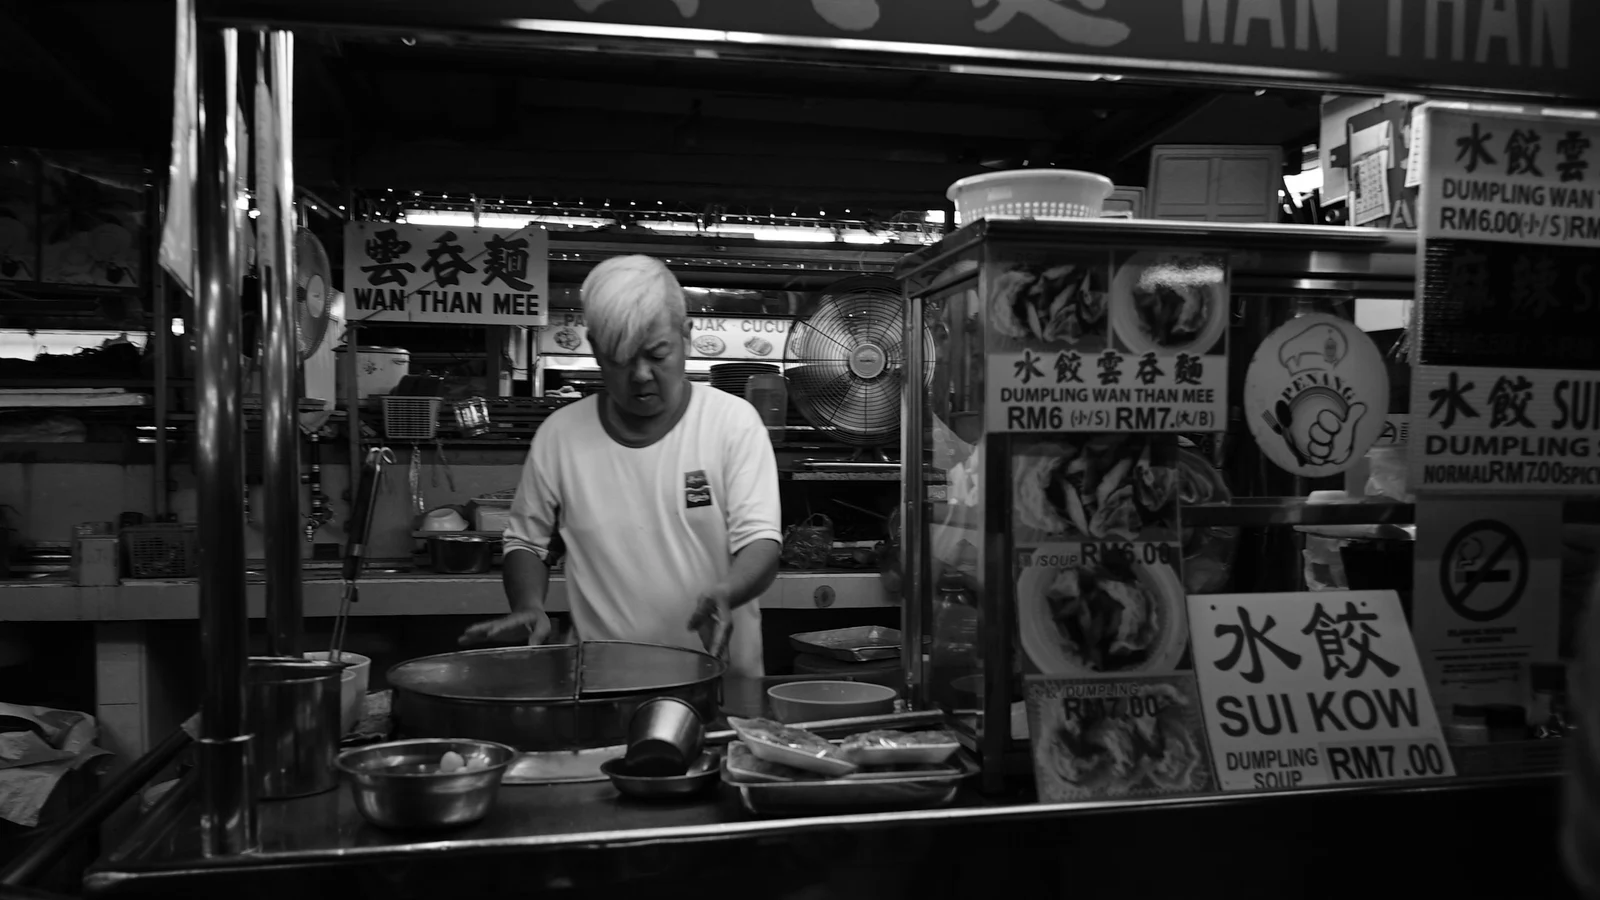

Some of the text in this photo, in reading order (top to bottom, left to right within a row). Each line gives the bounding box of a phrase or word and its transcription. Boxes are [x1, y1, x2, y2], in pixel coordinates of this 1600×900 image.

[1455, 122, 1591, 183] 水餃雲
[1442, 178, 1594, 210] DUMPLING WAN
[353, 287, 539, 316] WAN THAN MEE
[741, 319, 793, 334] CUCU
[1001, 387, 1215, 404] DUMPLING WAN THAN MEE
[1428, 371, 1537, 430] 水餃
[1007, 406, 1063, 430] RM6
[1425, 434, 1591, 458] DUMPLING
[1562, 465, 1600, 485] SPIC
[1080, 542, 1171, 566] RM6.00
[1213, 601, 1400, 684] 水餃
[1215, 687, 1420, 738] SUI KOW
[1226, 747, 1319, 771] DUMPLING
[1253, 770, 1303, 789] SOUP
